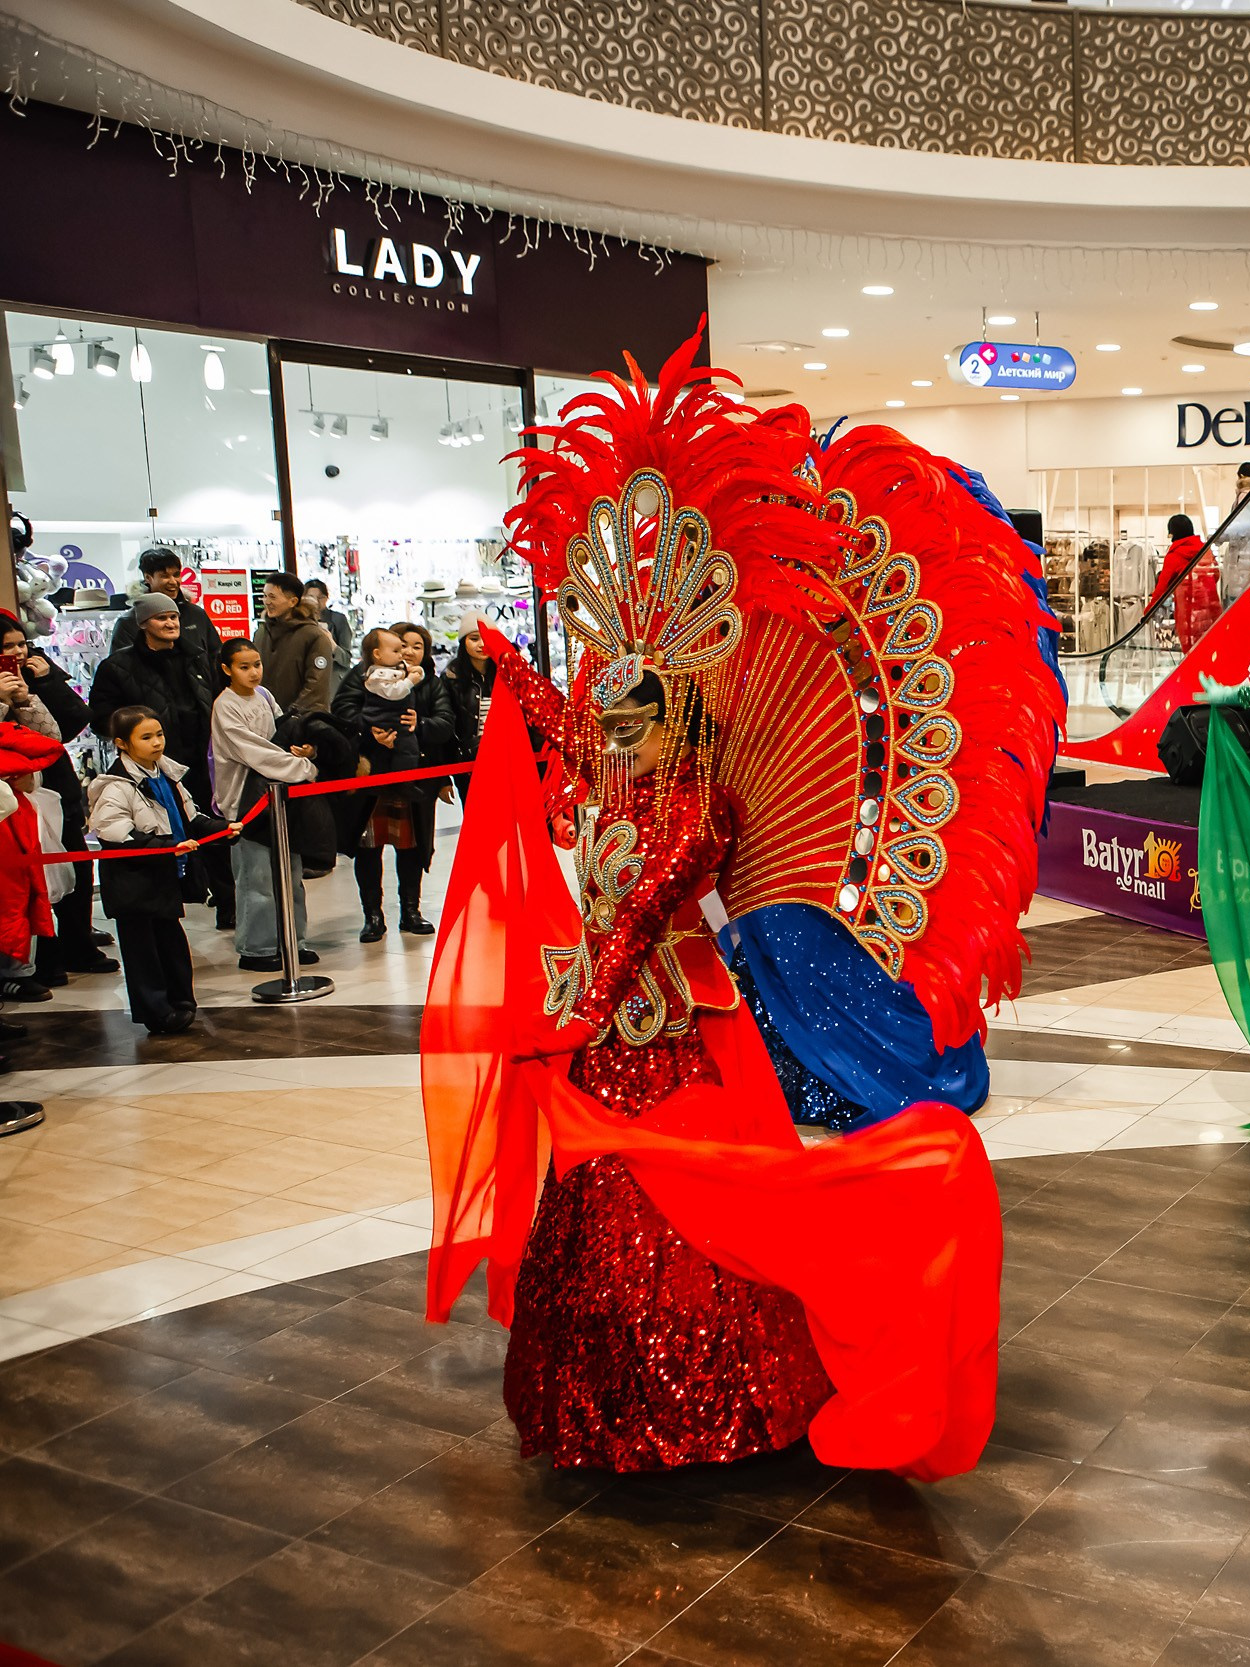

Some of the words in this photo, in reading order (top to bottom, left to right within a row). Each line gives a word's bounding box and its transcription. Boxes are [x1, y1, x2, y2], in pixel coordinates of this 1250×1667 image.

[334, 227, 481, 296] LADY
[332, 283, 470, 313] COLLECTION
[970, 359, 981, 375] 2
[997, 365, 1042, 379] Детский
[1044, 369, 1066, 383] мир
[225, 605, 242, 614] RED
[222, 629, 245, 637] KREDIT
[1081, 828, 1144, 892] Batyr
[1134, 880, 1166, 900] mall
